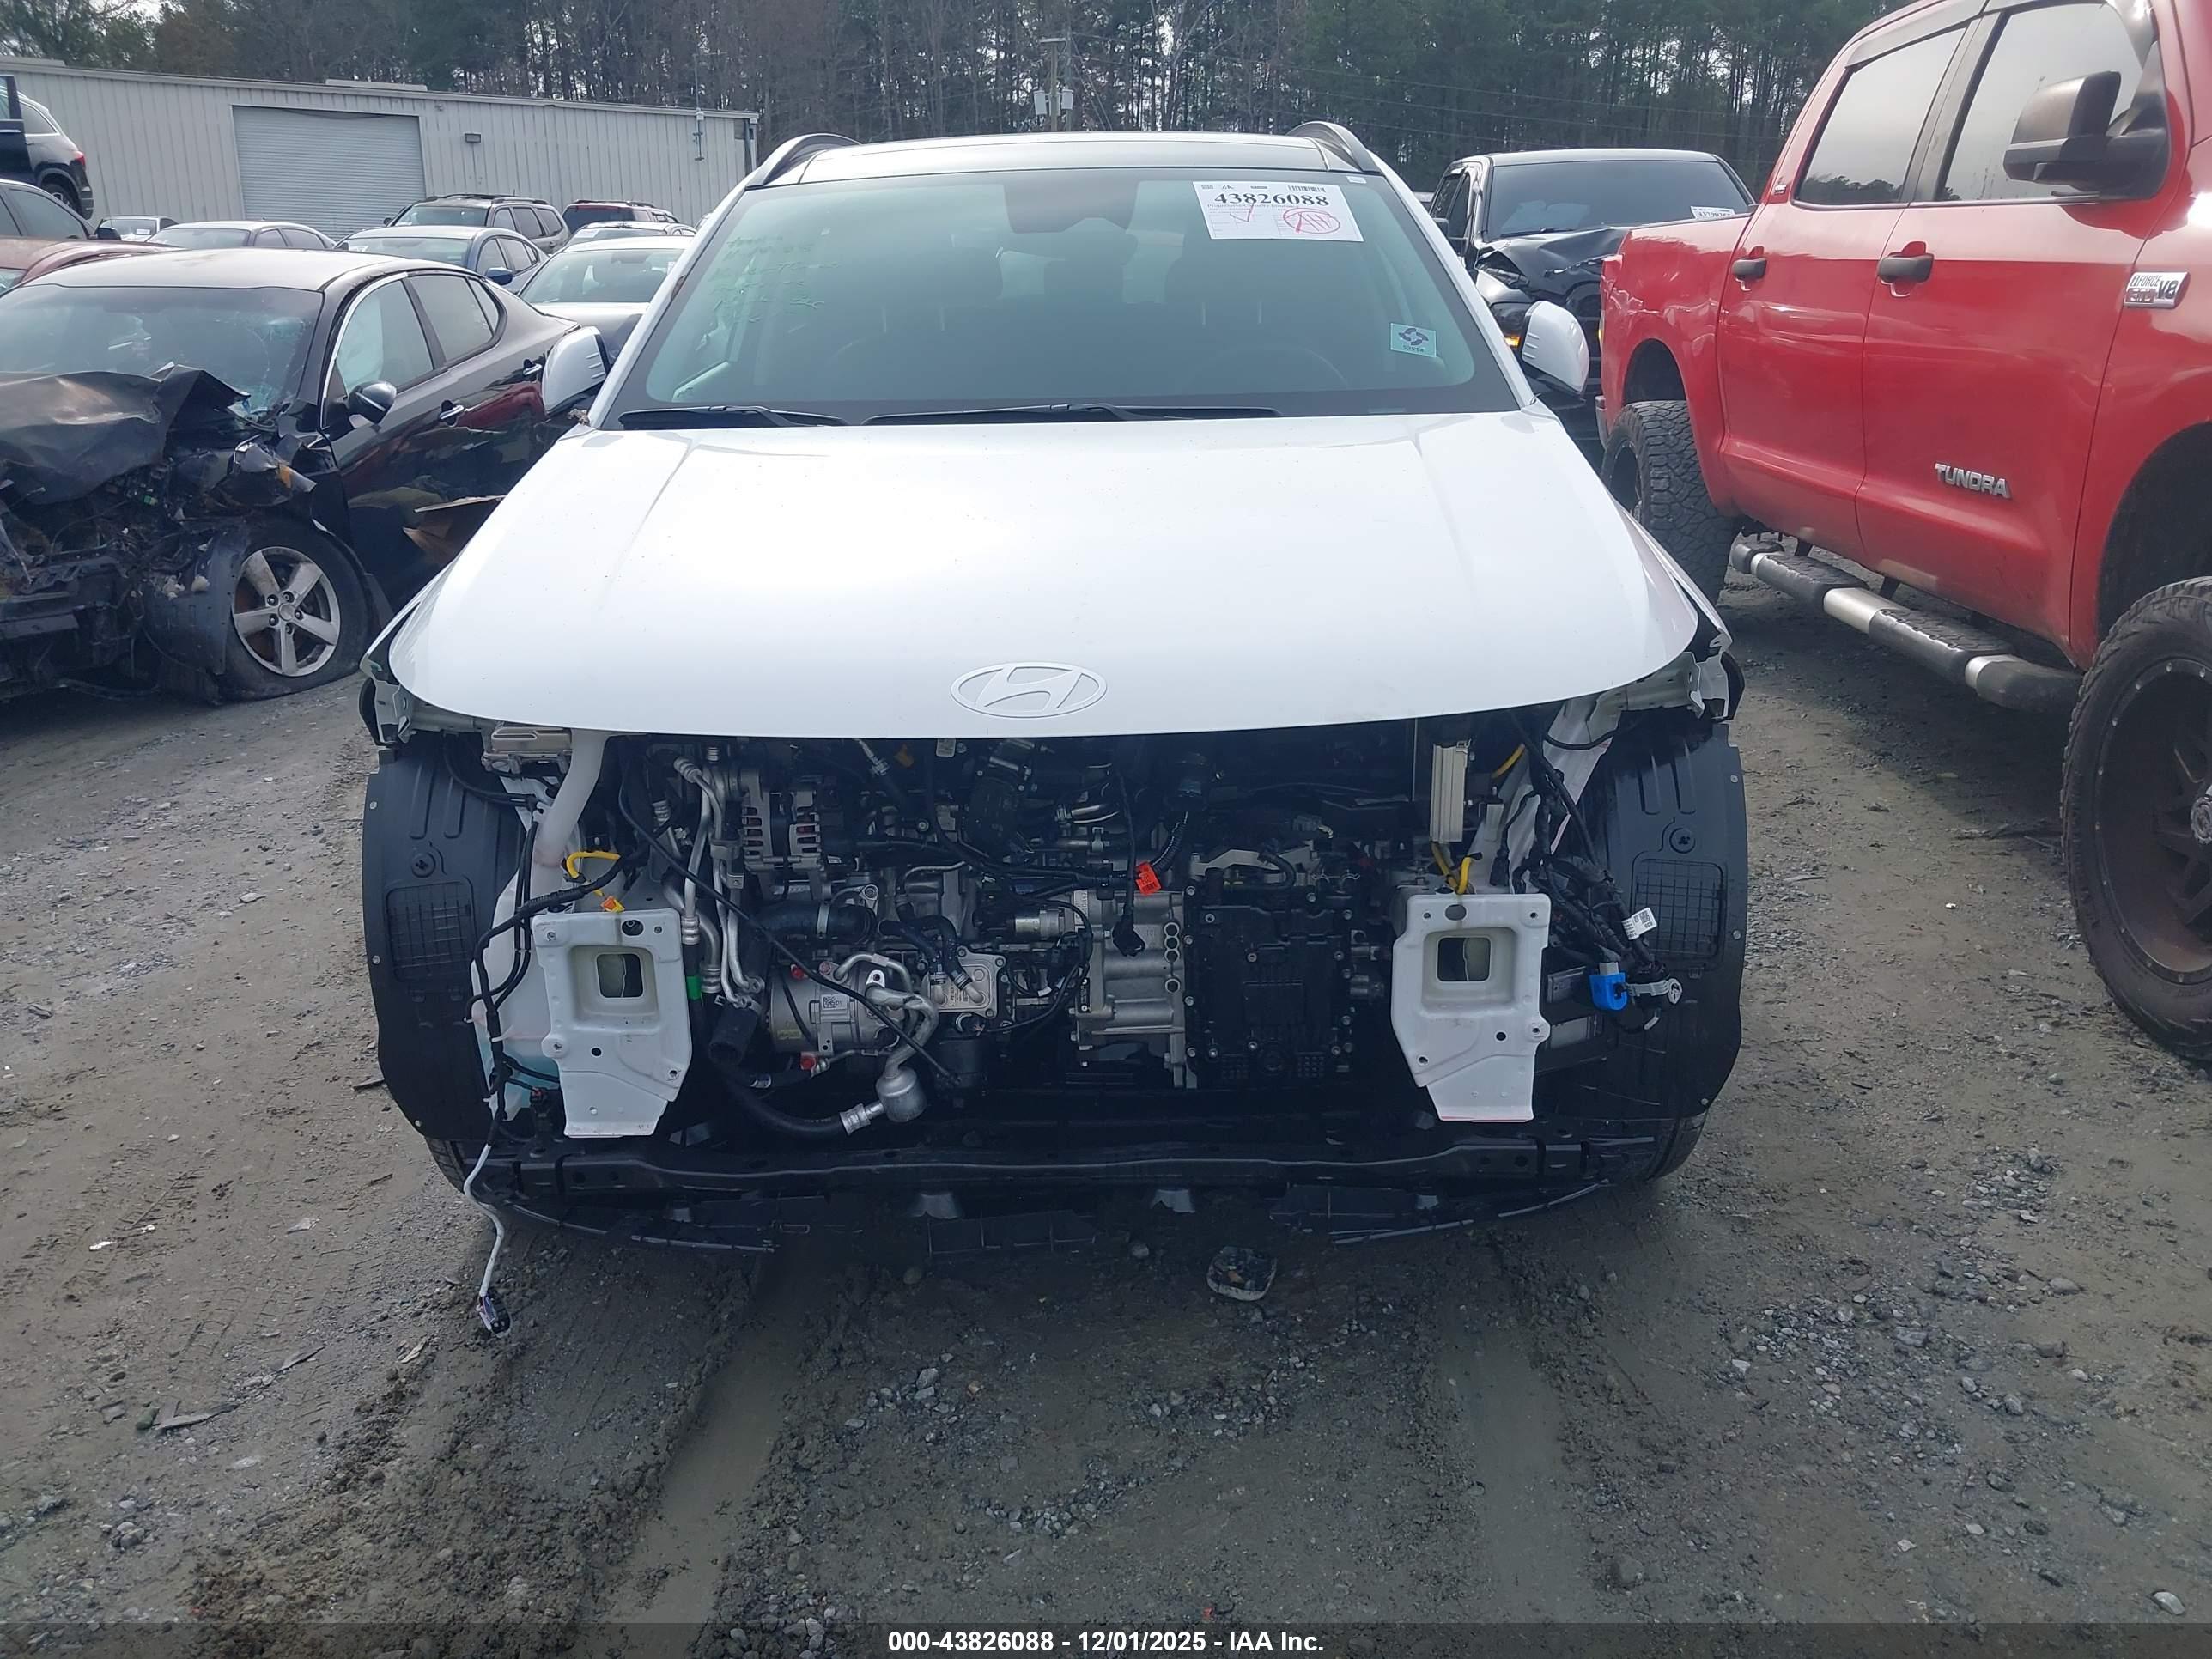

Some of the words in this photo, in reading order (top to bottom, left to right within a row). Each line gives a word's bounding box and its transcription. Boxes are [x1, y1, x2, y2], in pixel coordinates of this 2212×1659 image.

[1214, 192, 1329, 207] 43826088
[2157, 279, 2179, 300] V8
[1935, 462, 2011, 499] TUNDRA
